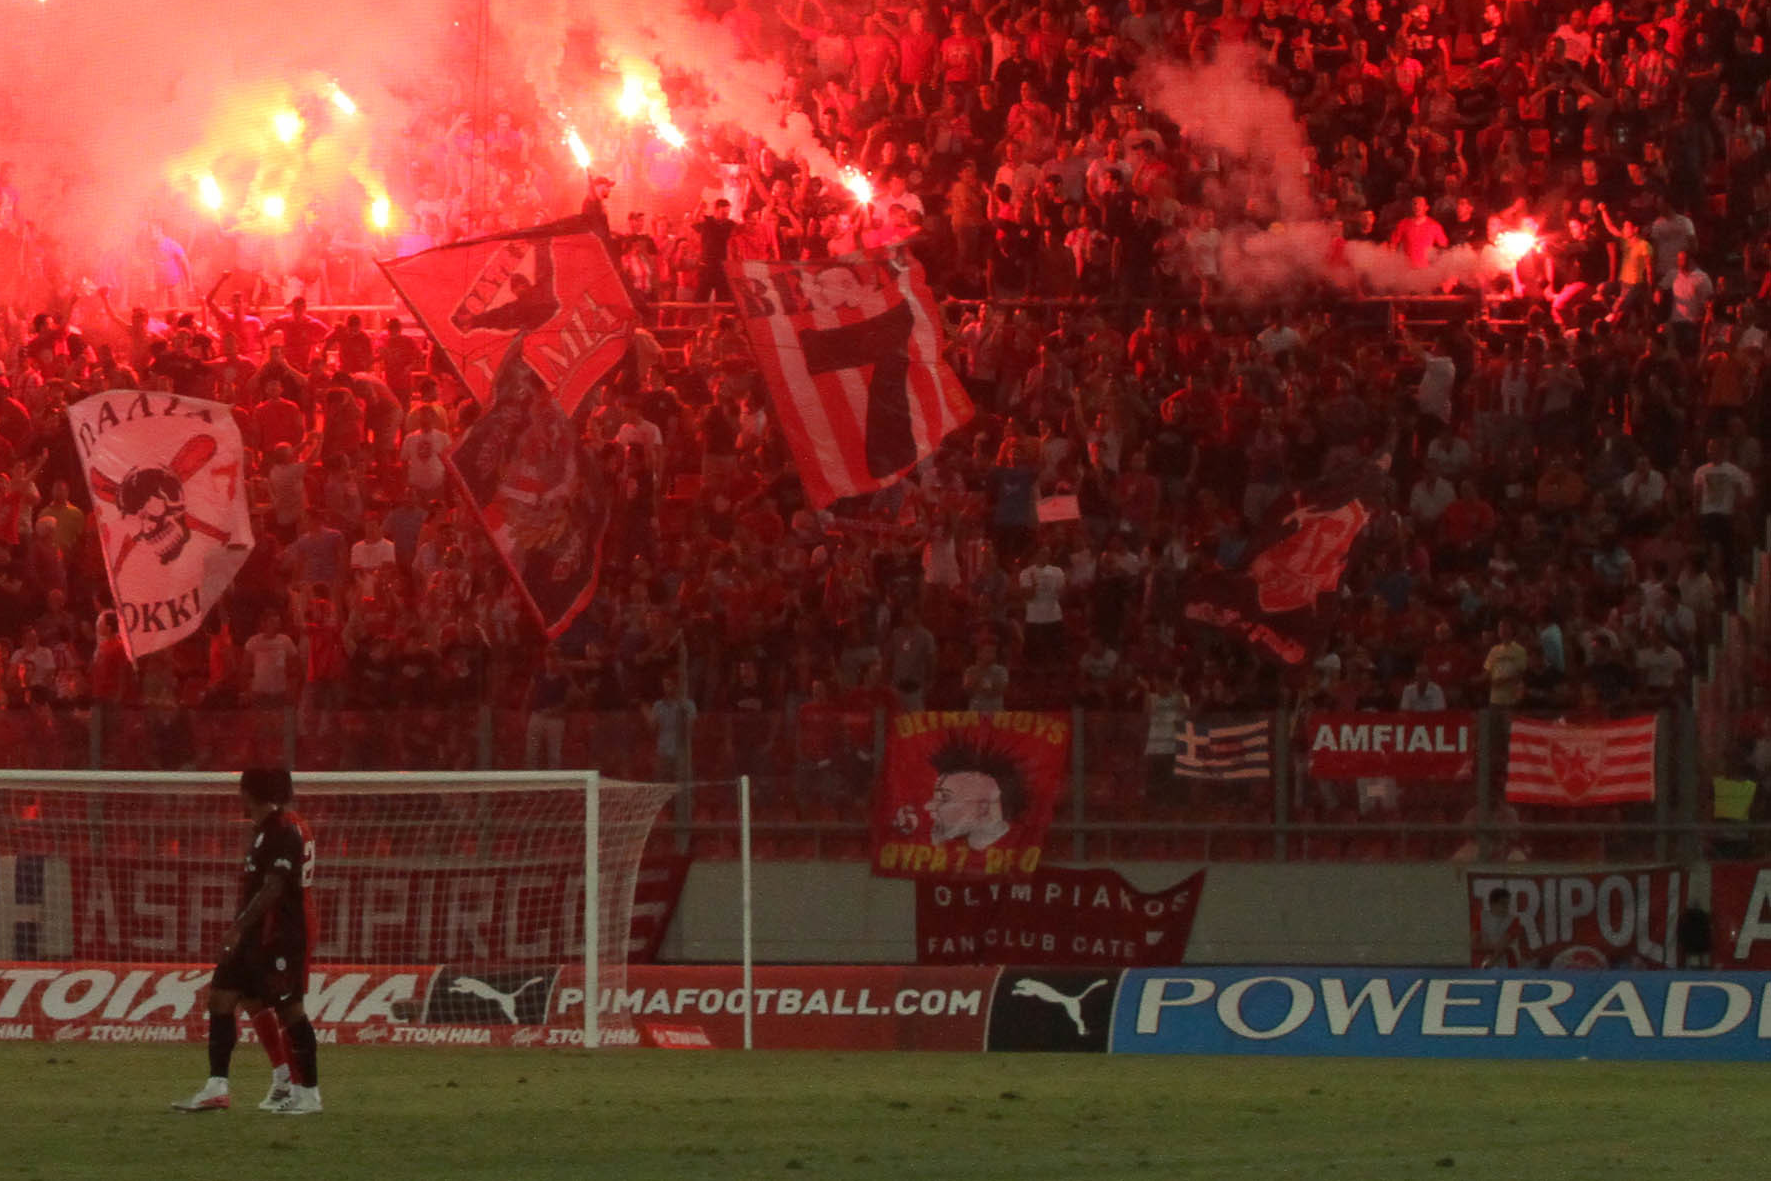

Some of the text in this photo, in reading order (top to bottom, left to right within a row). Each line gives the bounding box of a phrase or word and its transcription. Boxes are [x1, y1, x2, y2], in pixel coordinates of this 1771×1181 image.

[1312, 723, 1469, 754] AMFIALI
[80, 863, 669, 960] ASPOPIRGOS
[1474, 872, 1681, 966] TRIPOLI
[926, 934, 976, 955] FAN
[982, 927, 1056, 953] CLUB
[557, 986, 982, 1016] PUMAFOOTBALL.COM
[1135, 976, 1771, 1040] POWERAD
